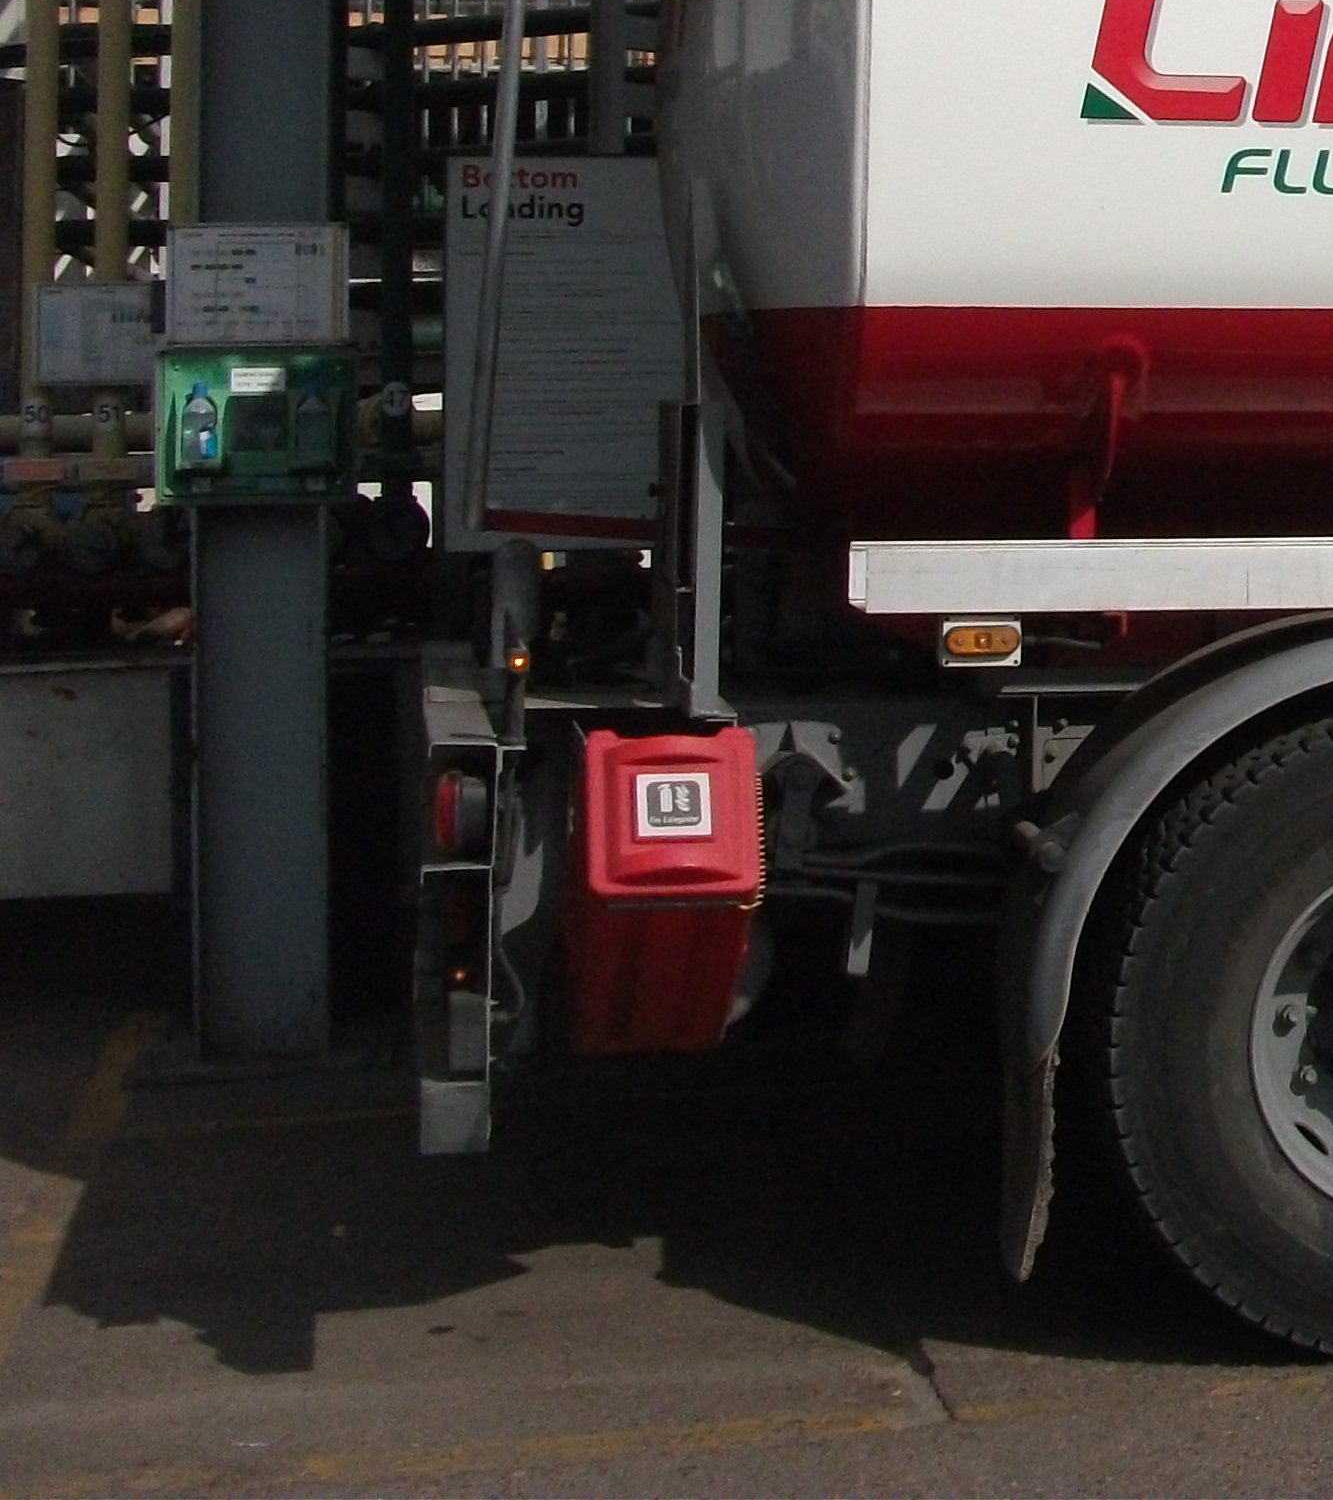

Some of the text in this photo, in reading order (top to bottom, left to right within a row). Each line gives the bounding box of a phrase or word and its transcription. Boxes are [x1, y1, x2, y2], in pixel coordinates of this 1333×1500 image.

[462, 164, 578, 189] Btom
[25, 405, 48, 423] 50
[99, 404, 119, 423] 51
